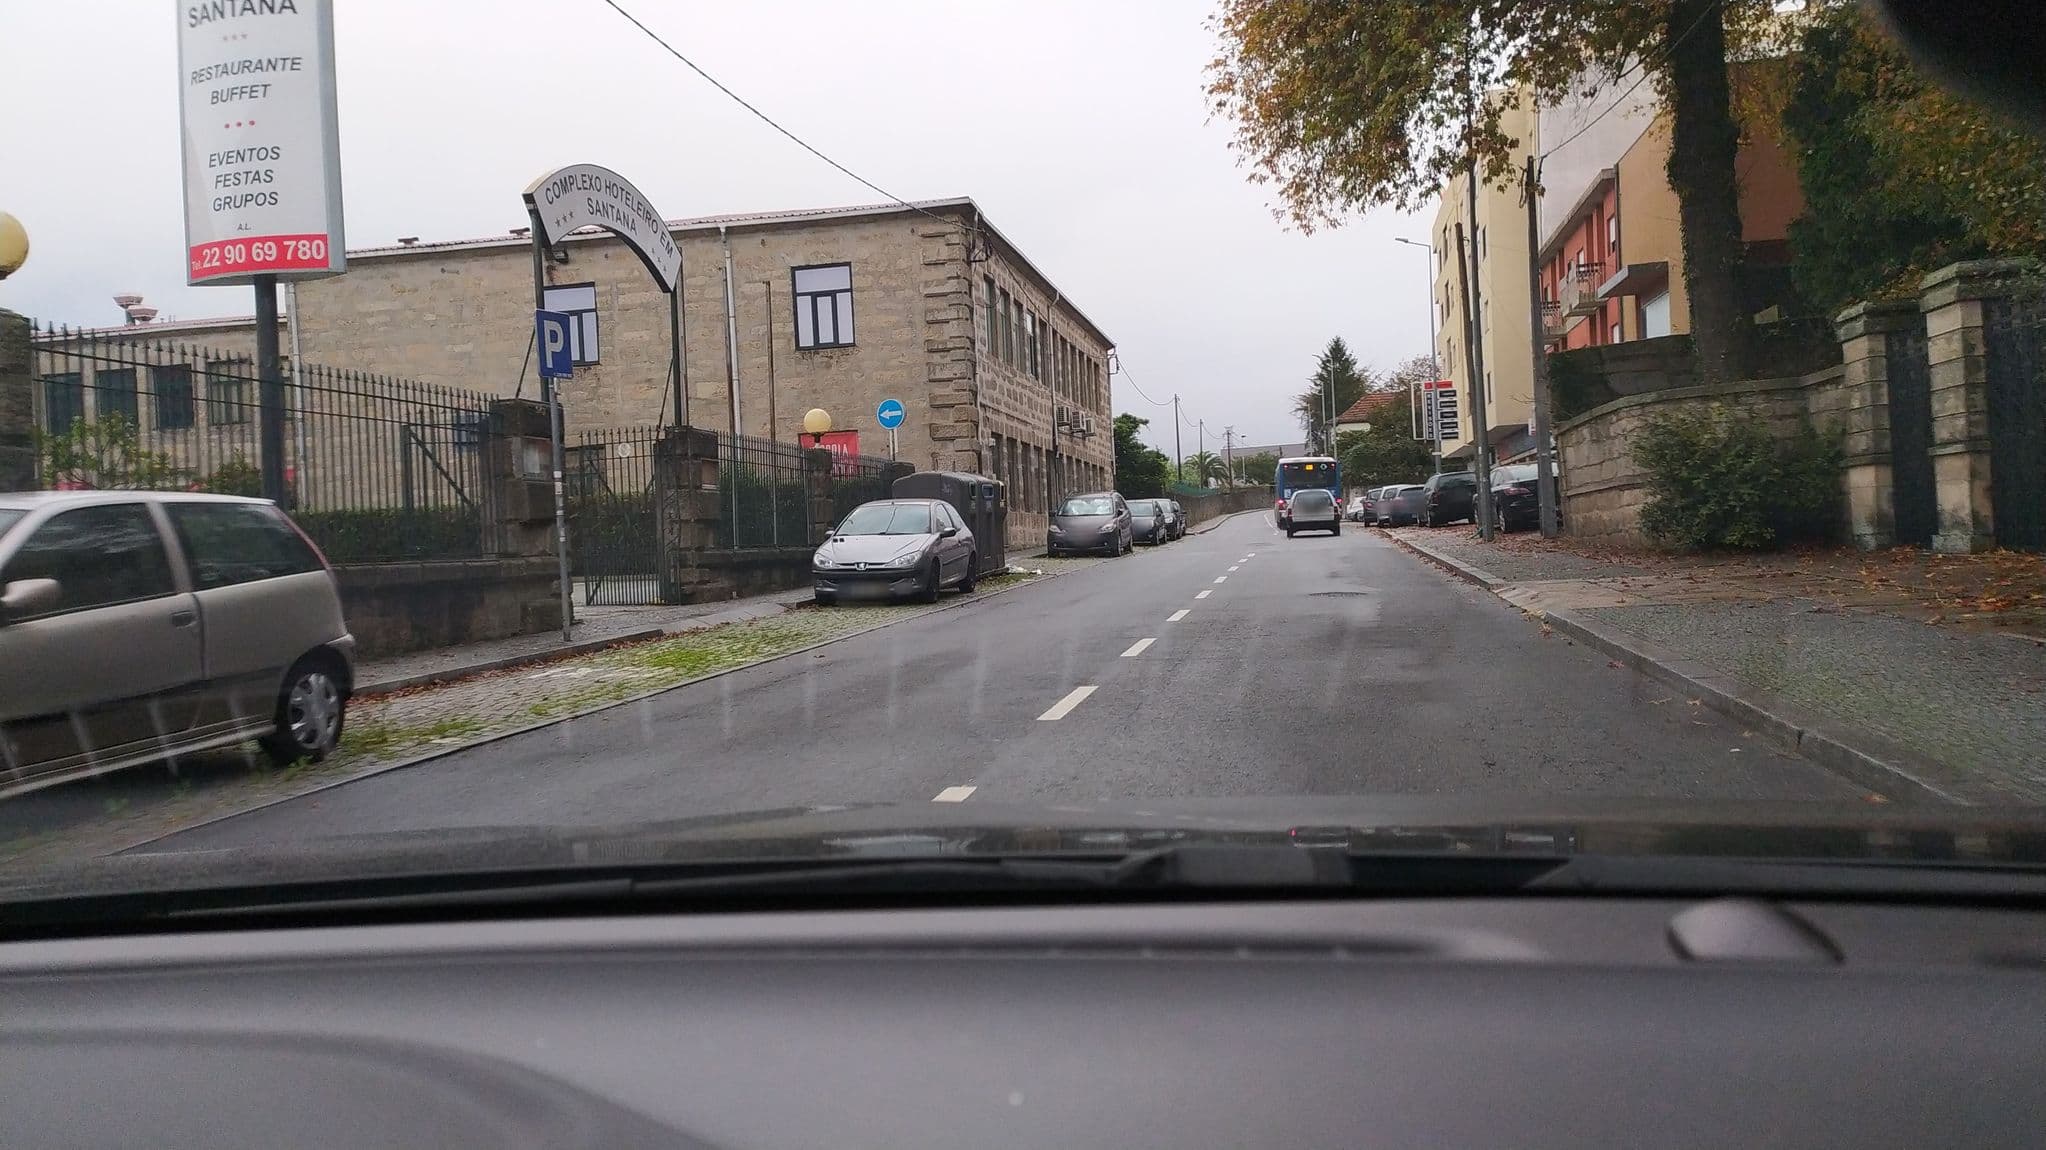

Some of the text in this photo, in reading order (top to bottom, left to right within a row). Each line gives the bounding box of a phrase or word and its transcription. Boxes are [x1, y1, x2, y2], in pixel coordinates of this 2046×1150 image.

[188, 0, 298, 28] SANTANA
[190, 56, 303, 86] RESTAURANTE
[210, 83, 272, 105] BUFFET
[209, 146, 281, 168] EVENTOS
[214, 168, 274, 190] FESTAS
[212, 191, 279, 212] GRUPOS
[545, 173, 674, 259] COMPLEXO HOTELEIRO EM
[586, 197, 638, 236] SANTANA
[202, 246, 221, 268] 22
[224, 243, 246, 265] 90
[251, 241, 277, 262] 69
[283, 239, 325, 260] 780
[543, 319, 564, 369] P
